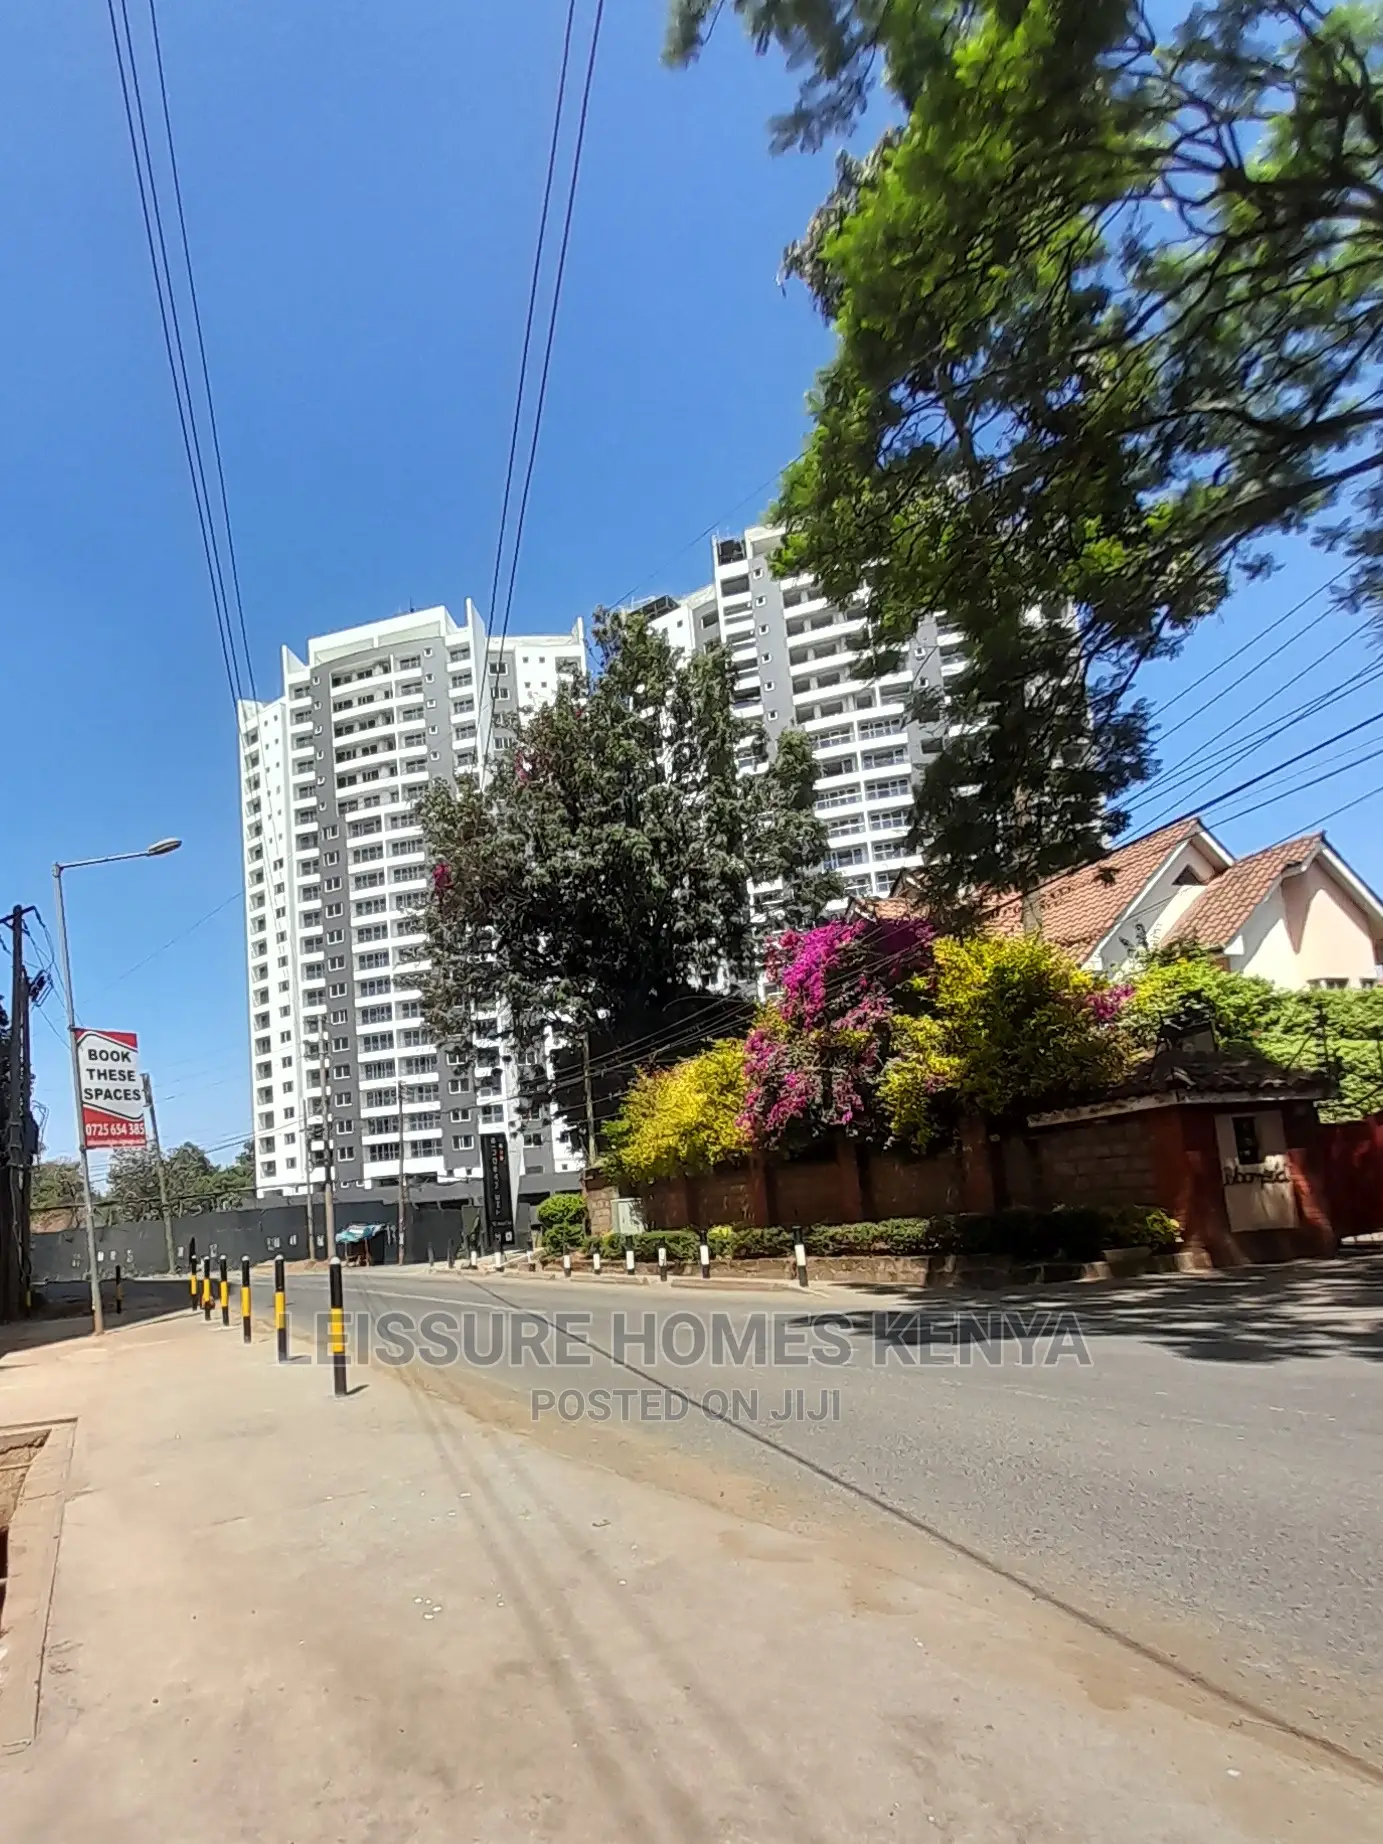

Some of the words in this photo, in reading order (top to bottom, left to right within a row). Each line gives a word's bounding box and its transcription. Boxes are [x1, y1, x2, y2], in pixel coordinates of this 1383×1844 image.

[88, 1049, 131, 1062] BOOK
[86, 1068, 136, 1081] THESE
[84, 1088, 141, 1101] SPACES
[85, 1123, 109, 1136] 0725
[110, 1123, 127, 1136] 654
